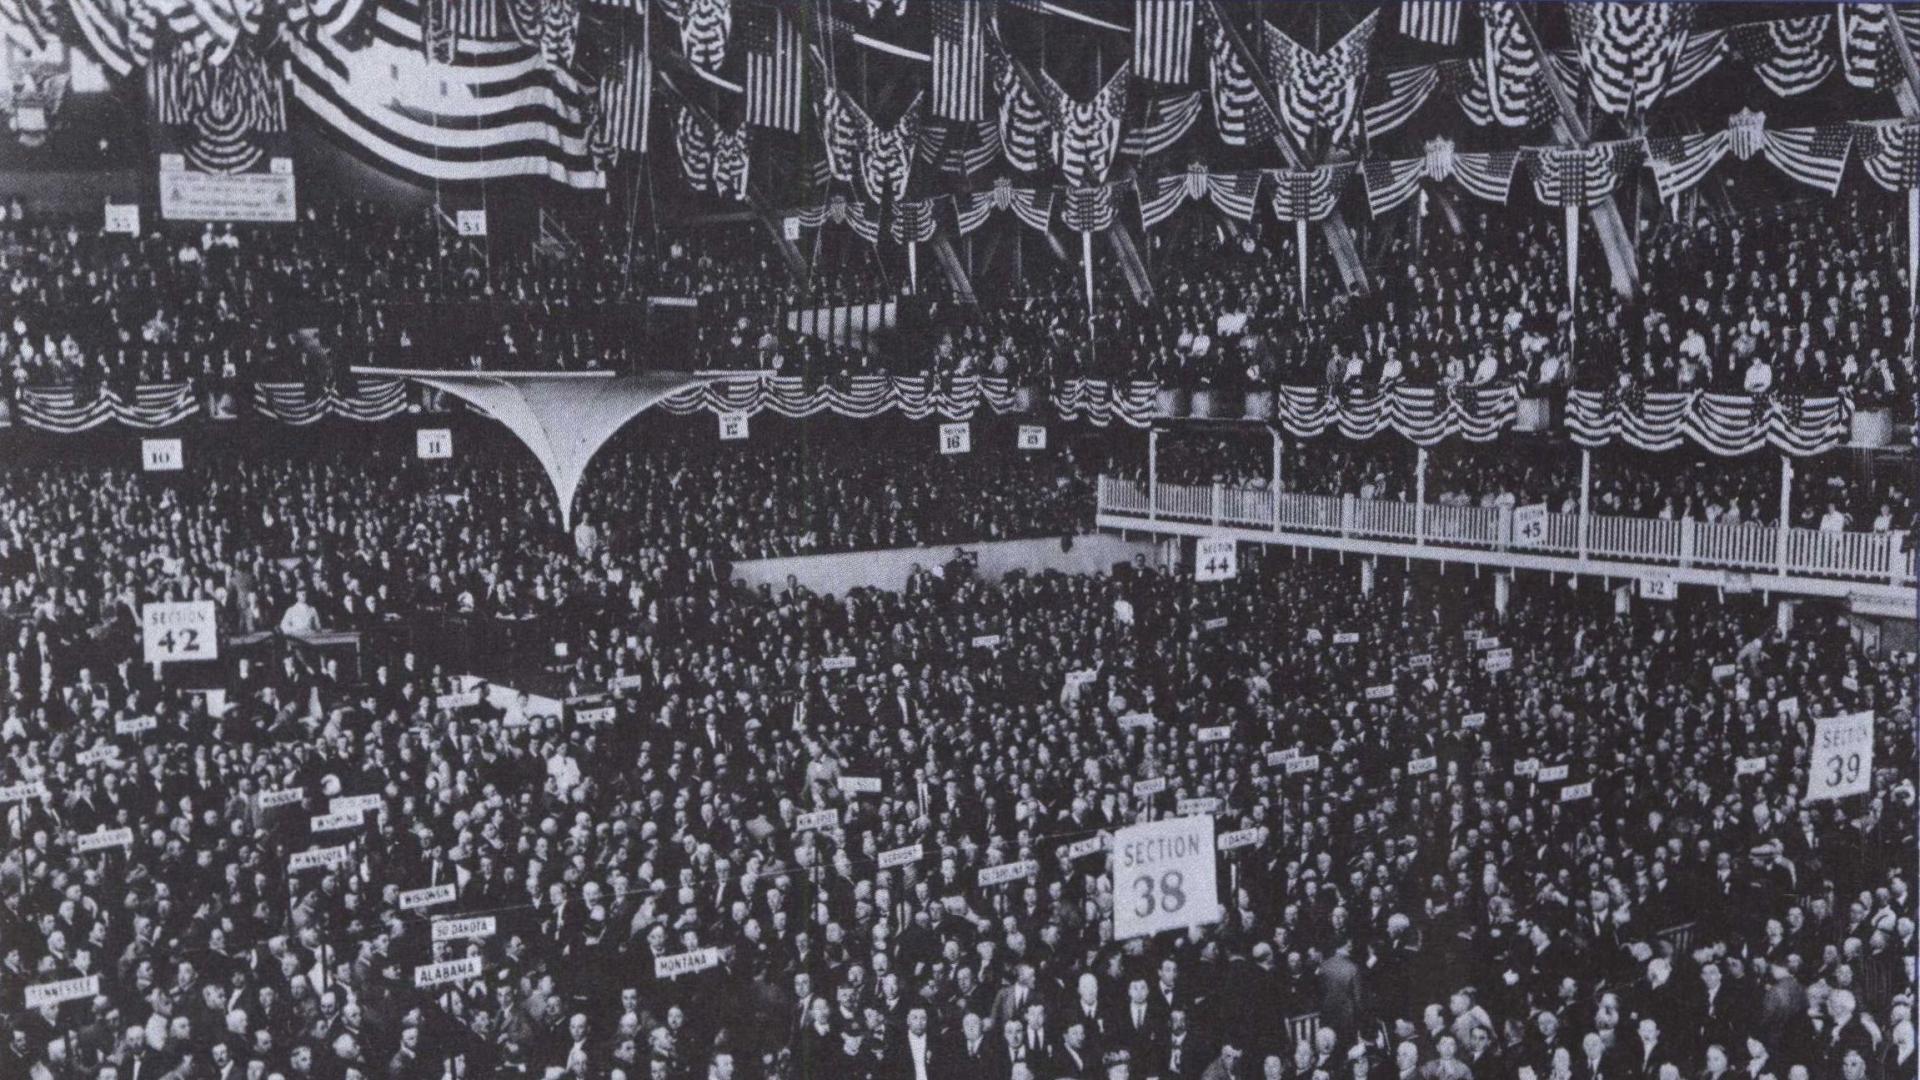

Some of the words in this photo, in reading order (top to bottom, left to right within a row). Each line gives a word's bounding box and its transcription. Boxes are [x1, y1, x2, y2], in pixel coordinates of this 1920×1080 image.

[1522, 522, 1541, 538] 45
[1204, 557, 1229, 574] 44
[152, 611, 206, 627] SECTION
[158, 629, 200, 653] 42
[1826, 753, 1861, 788] 39
[294, 850, 344, 864] MINNESOTA
[1123, 842, 1200, 870] SECTION
[404, 887, 451, 905] WISCONSIN
[1132, 870, 1186, 918] 38
[452, 920, 489, 936] DAKOTA
[420, 960, 476, 984] ALABAMA
[660, 953, 708, 973] MONTANA
